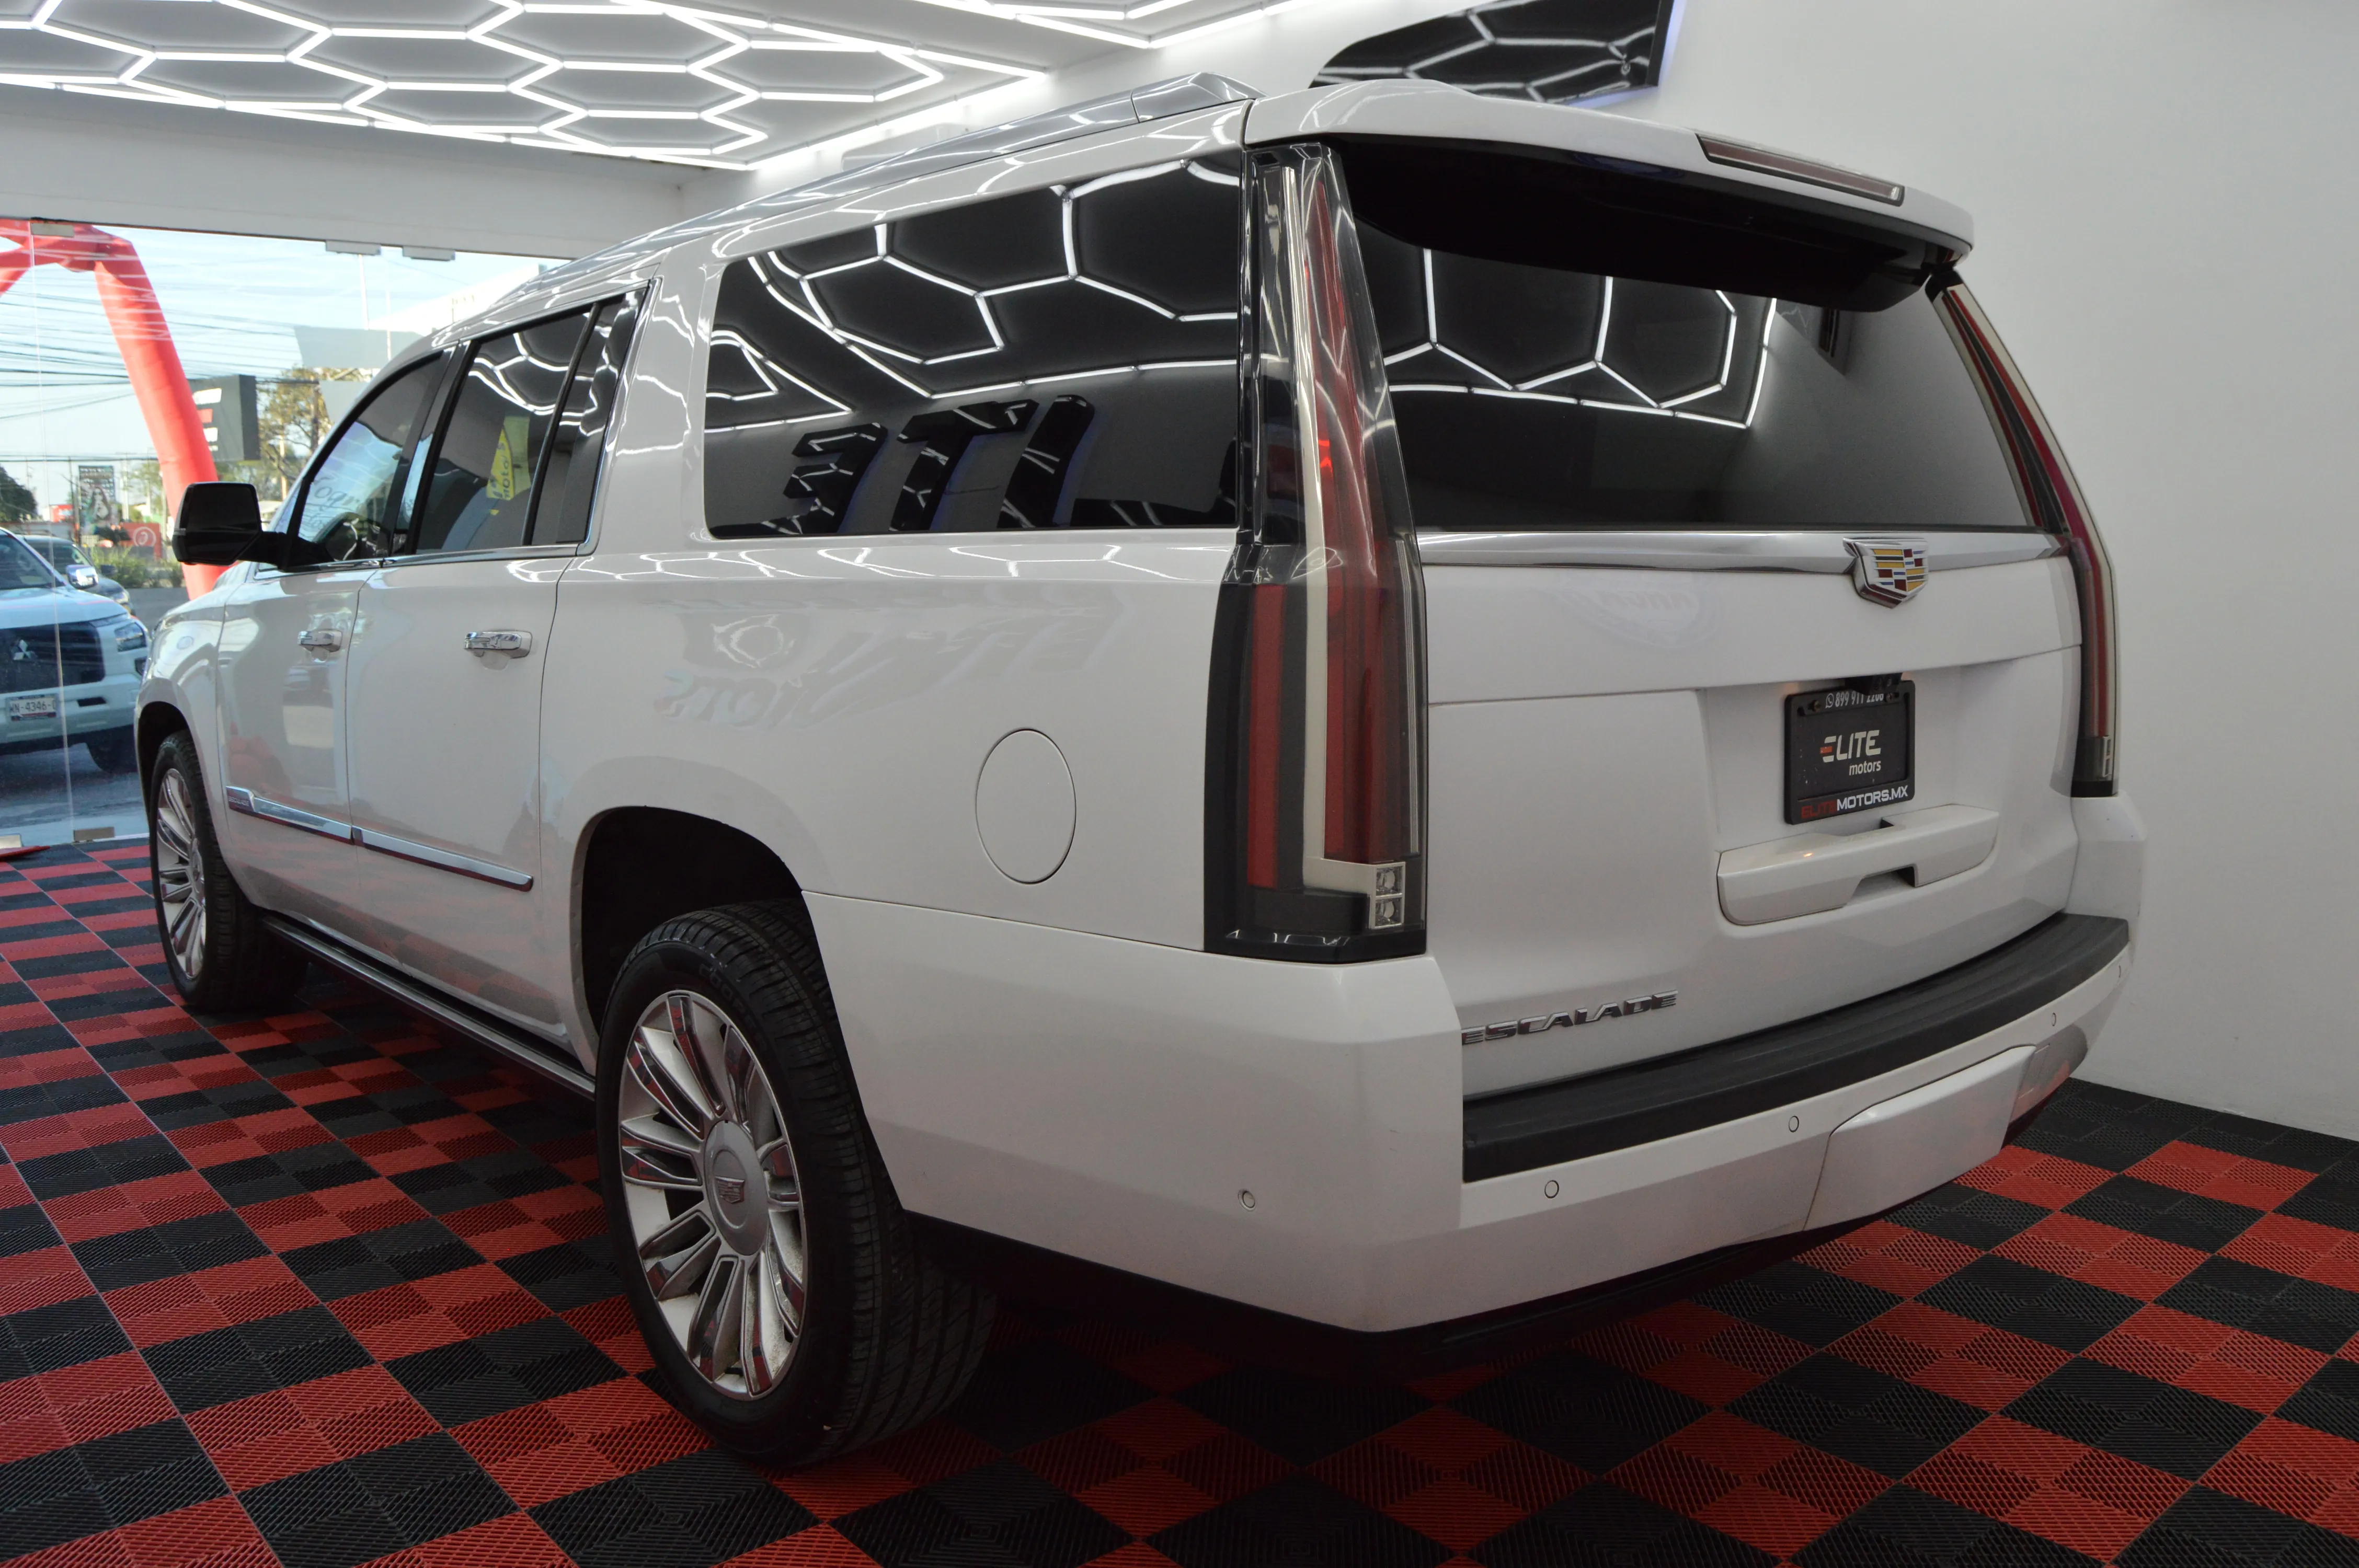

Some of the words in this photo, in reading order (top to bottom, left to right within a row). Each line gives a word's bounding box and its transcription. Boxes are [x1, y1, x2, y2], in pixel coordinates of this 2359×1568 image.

[1835, 691, 1849, 707] 899
[1851, 690, 1864, 705] 911
[1820, 730, 1882, 763] ELITE
[1849, 760, 1882, 776] motors
[1461, 990, 1678, 1045] ESCALADE
